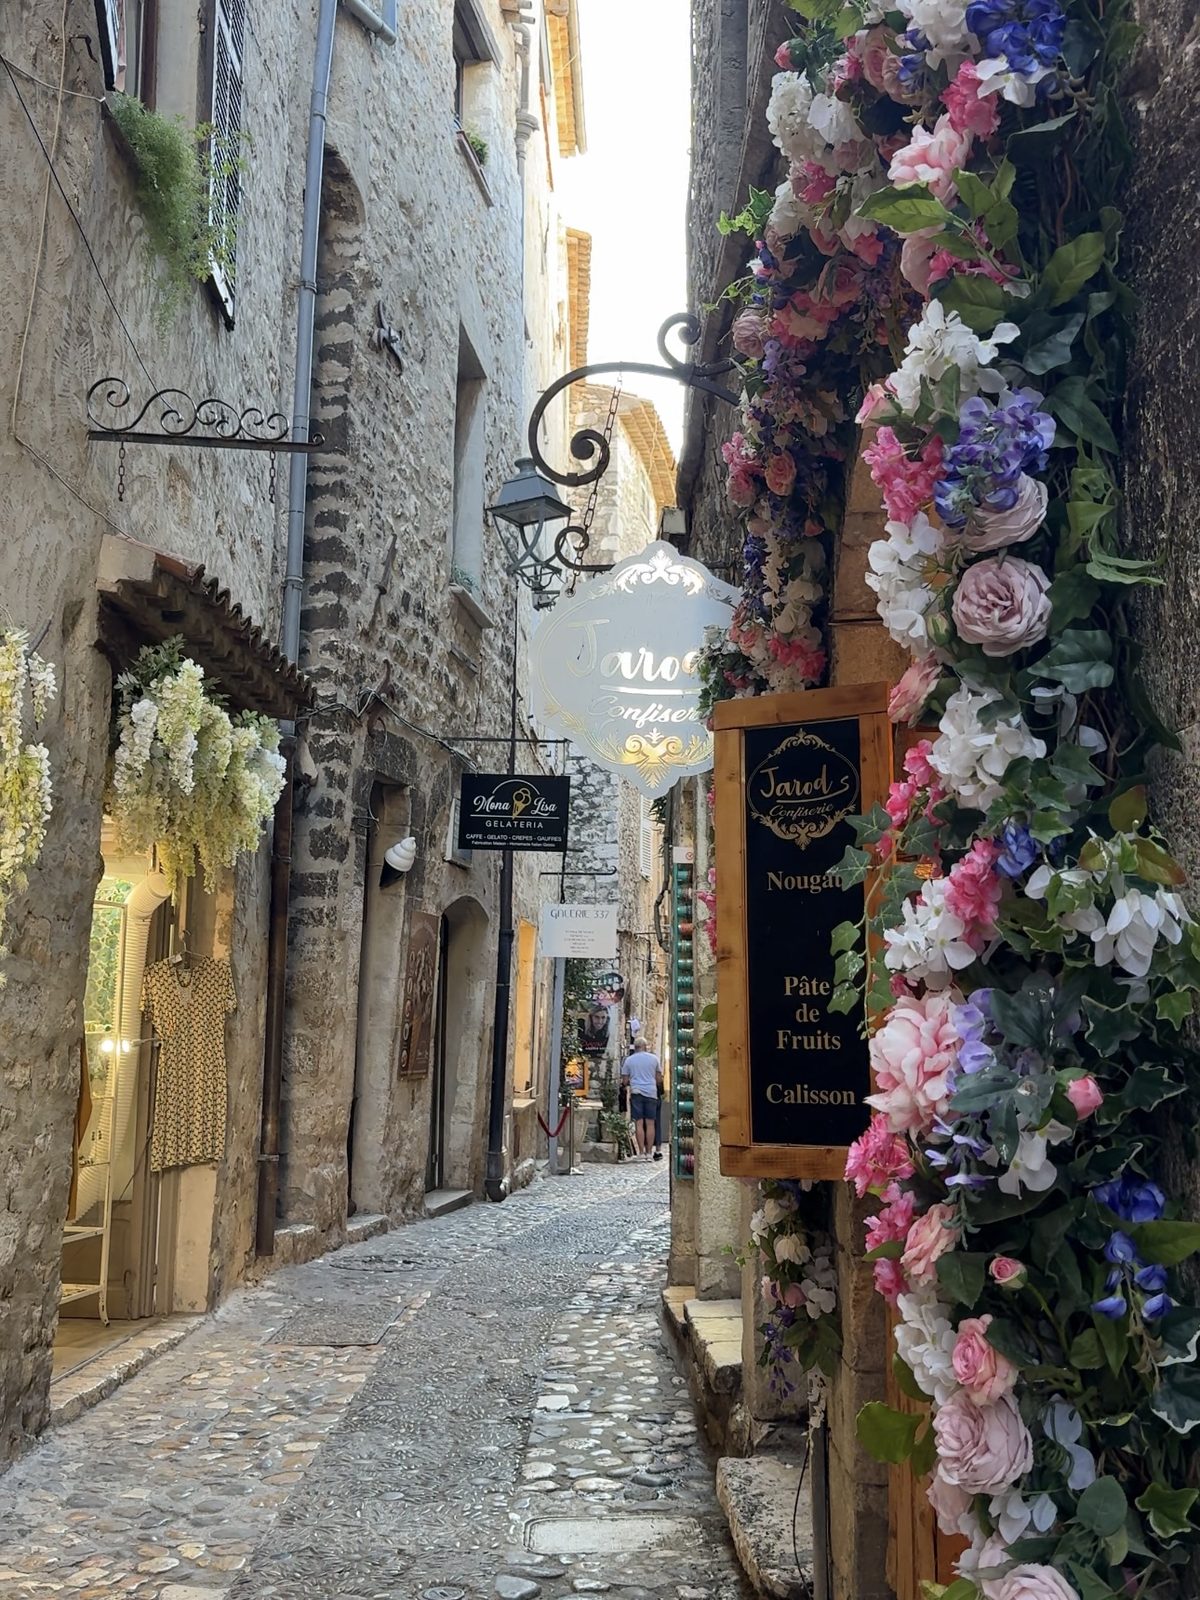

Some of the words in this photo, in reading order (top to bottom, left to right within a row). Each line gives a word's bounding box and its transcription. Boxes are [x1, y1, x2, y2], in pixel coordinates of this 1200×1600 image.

[473, 795, 511, 813] Mona
[531, 797, 558, 816] Lisa
[769, 802, 834, 820] Confiserie
[485, 820, 544, 829] GELATERIA
[594, 909, 610, 919] 337
[784, 975, 831, 996] Pâte
[795, 1003, 820, 1023] de
[776, 1030, 841, 1050] Fruits
[766, 1083, 856, 1105] Calisson
